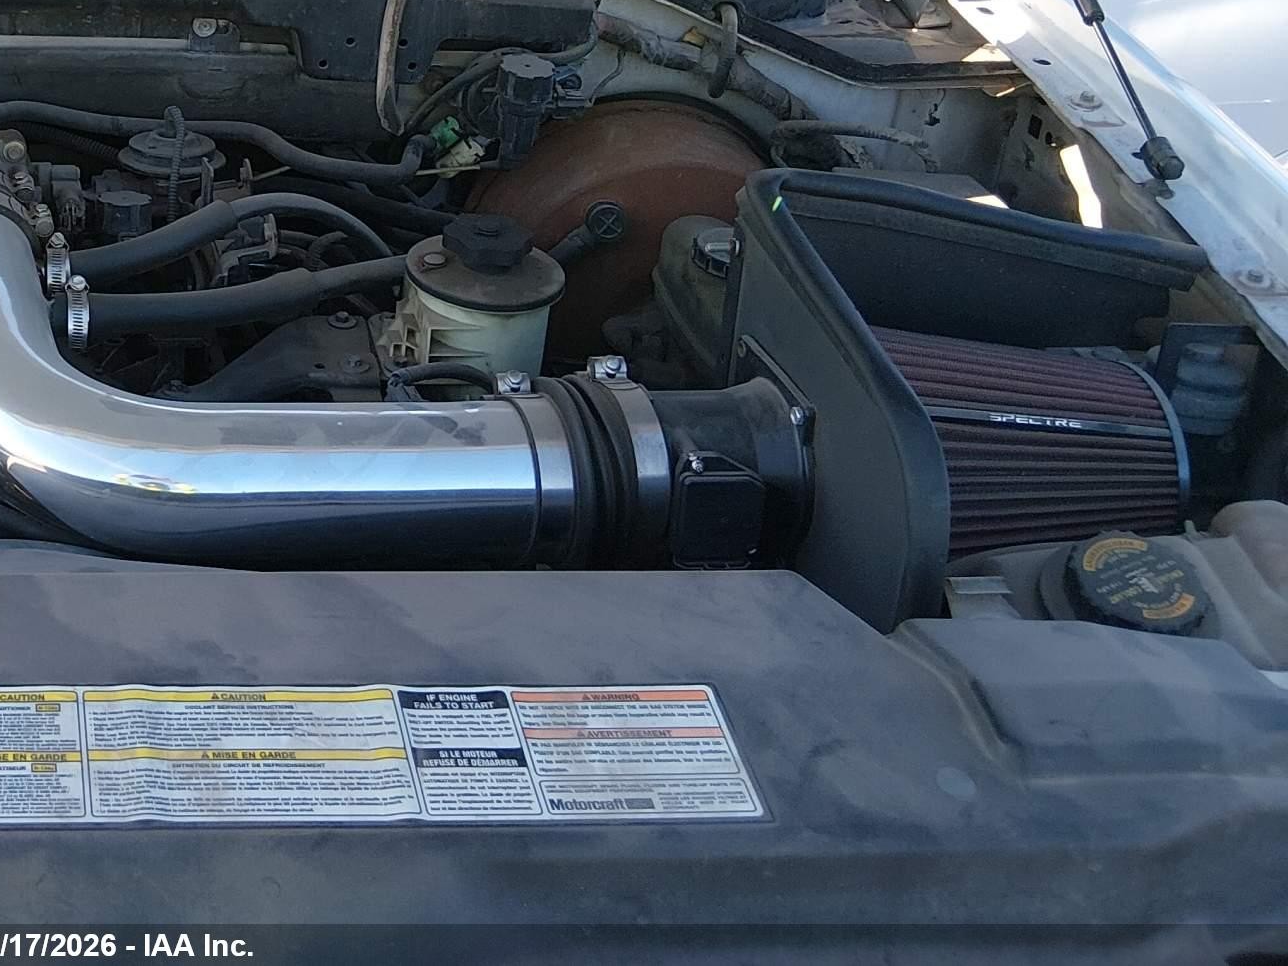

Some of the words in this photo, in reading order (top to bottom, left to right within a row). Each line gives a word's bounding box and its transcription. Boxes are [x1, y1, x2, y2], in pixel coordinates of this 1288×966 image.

[989, 413, 1083, 429] SPECTRE
[0, 693, 45, 701] CAUTION
[220, 693, 266, 702] CAUTION
[425, 694, 436, 702] IF
[438, 694, 478, 702] ENGINE
[590, 693, 640, 701] WARNING
[414, 701, 443, 709] FAILS
[444, 701, 459, 709] TO
[461, 701, 494, 709] START
[586, 730, 673, 738] AVERTISSEMENT
[13, 753, 27, 761] EN
[30, 753, 68, 761] GARDE
[212, 751, 238, 759] MISE
[241, 751, 256, 759] EN
[259, 751, 297, 759] GARDE
[439, 750, 449, 758] SI
[451, 750, 461, 758] LE
[462, 750, 498, 758] MOTEUR
[423, 759, 457, 767] REFUSE
[457, 759, 470, 767] DE
[549, 798, 626, 811] Motorcraft
